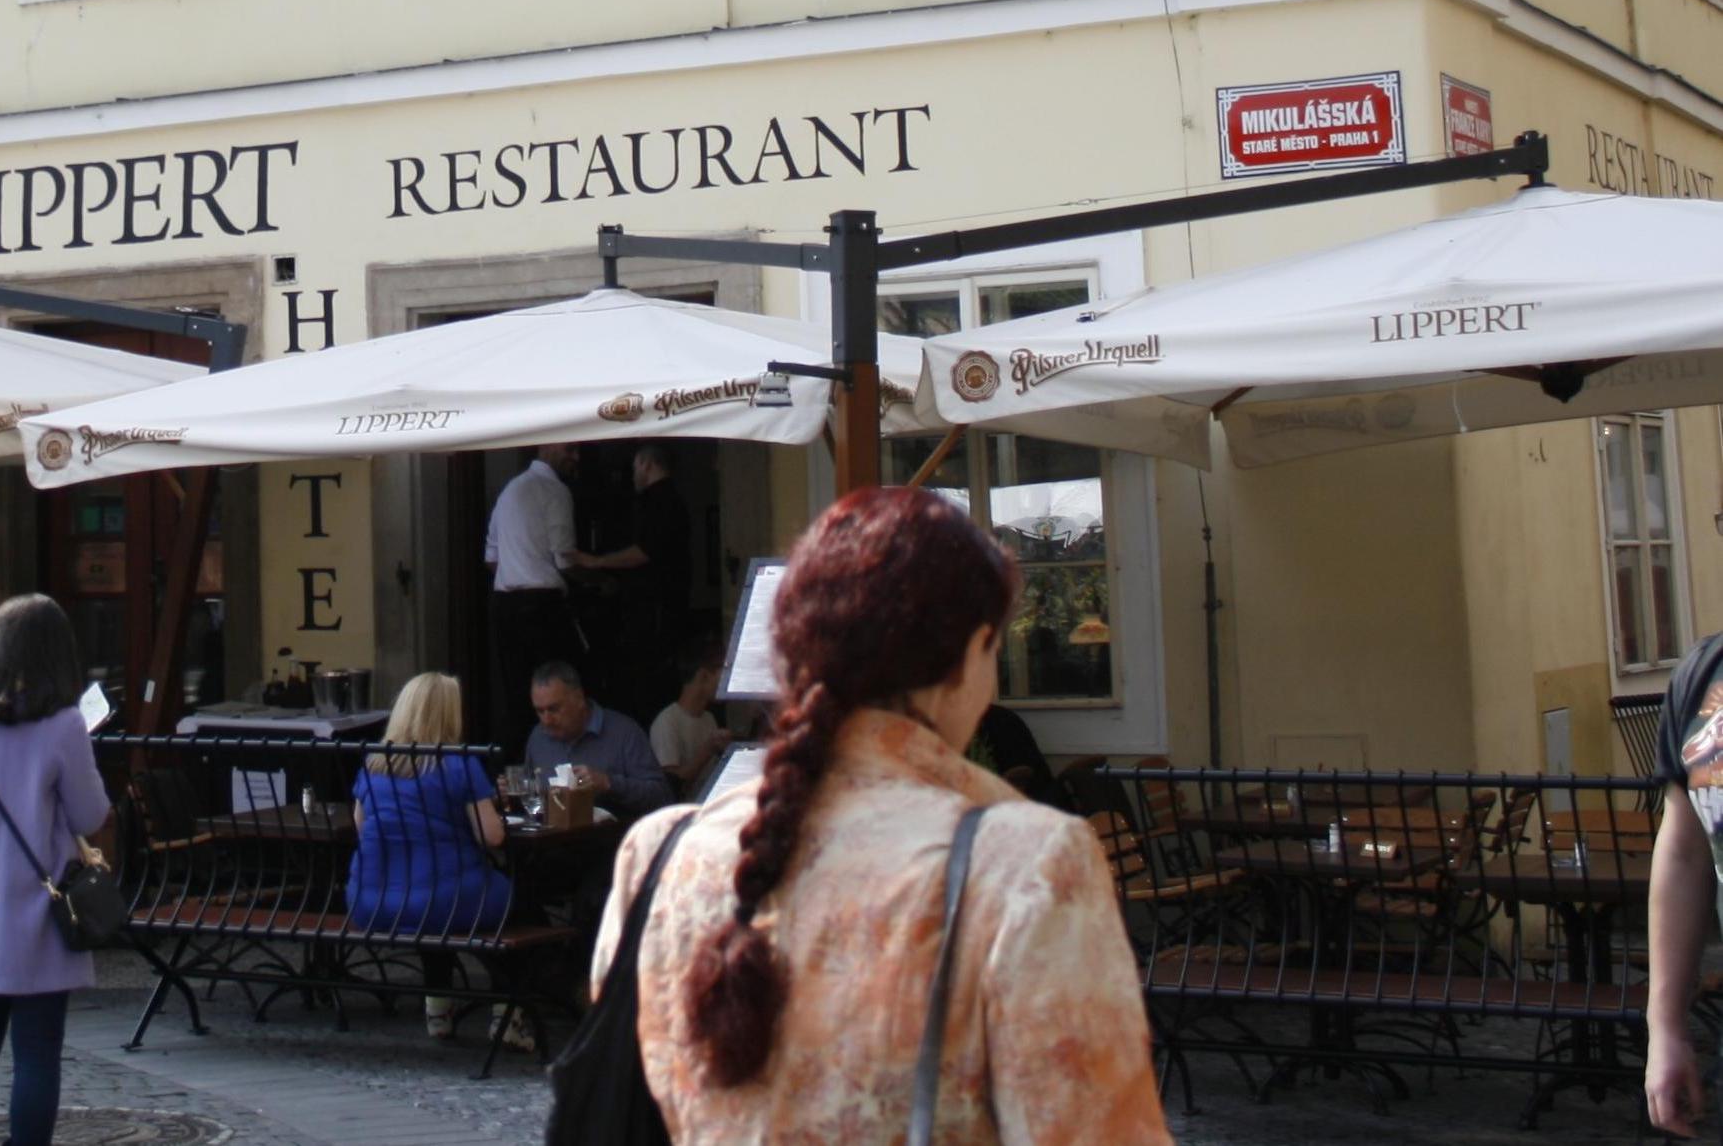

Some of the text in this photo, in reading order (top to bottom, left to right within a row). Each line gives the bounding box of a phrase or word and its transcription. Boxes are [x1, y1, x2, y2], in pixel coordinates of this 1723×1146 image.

[1241, 94, 1376, 134] MIKULÁŠSKÁ
[385, 104, 931, 218] RESTAURANT
[1242, 136, 1278, 154] STARÉ
[1280, 134, 1319, 151] MĚSTO
[1329, 131, 1370, 147] PRAHA
[1372, 130, 1379, 144] 1
[1371, 302, 1534, 343] LIPPERT
[1009, 348, 1086, 395] Pilsner
[1084, 334, 1160, 367] Urquell
[335, 410, 460, 435] LIPPERT
[654, 389, 722, 421] Pilsner
